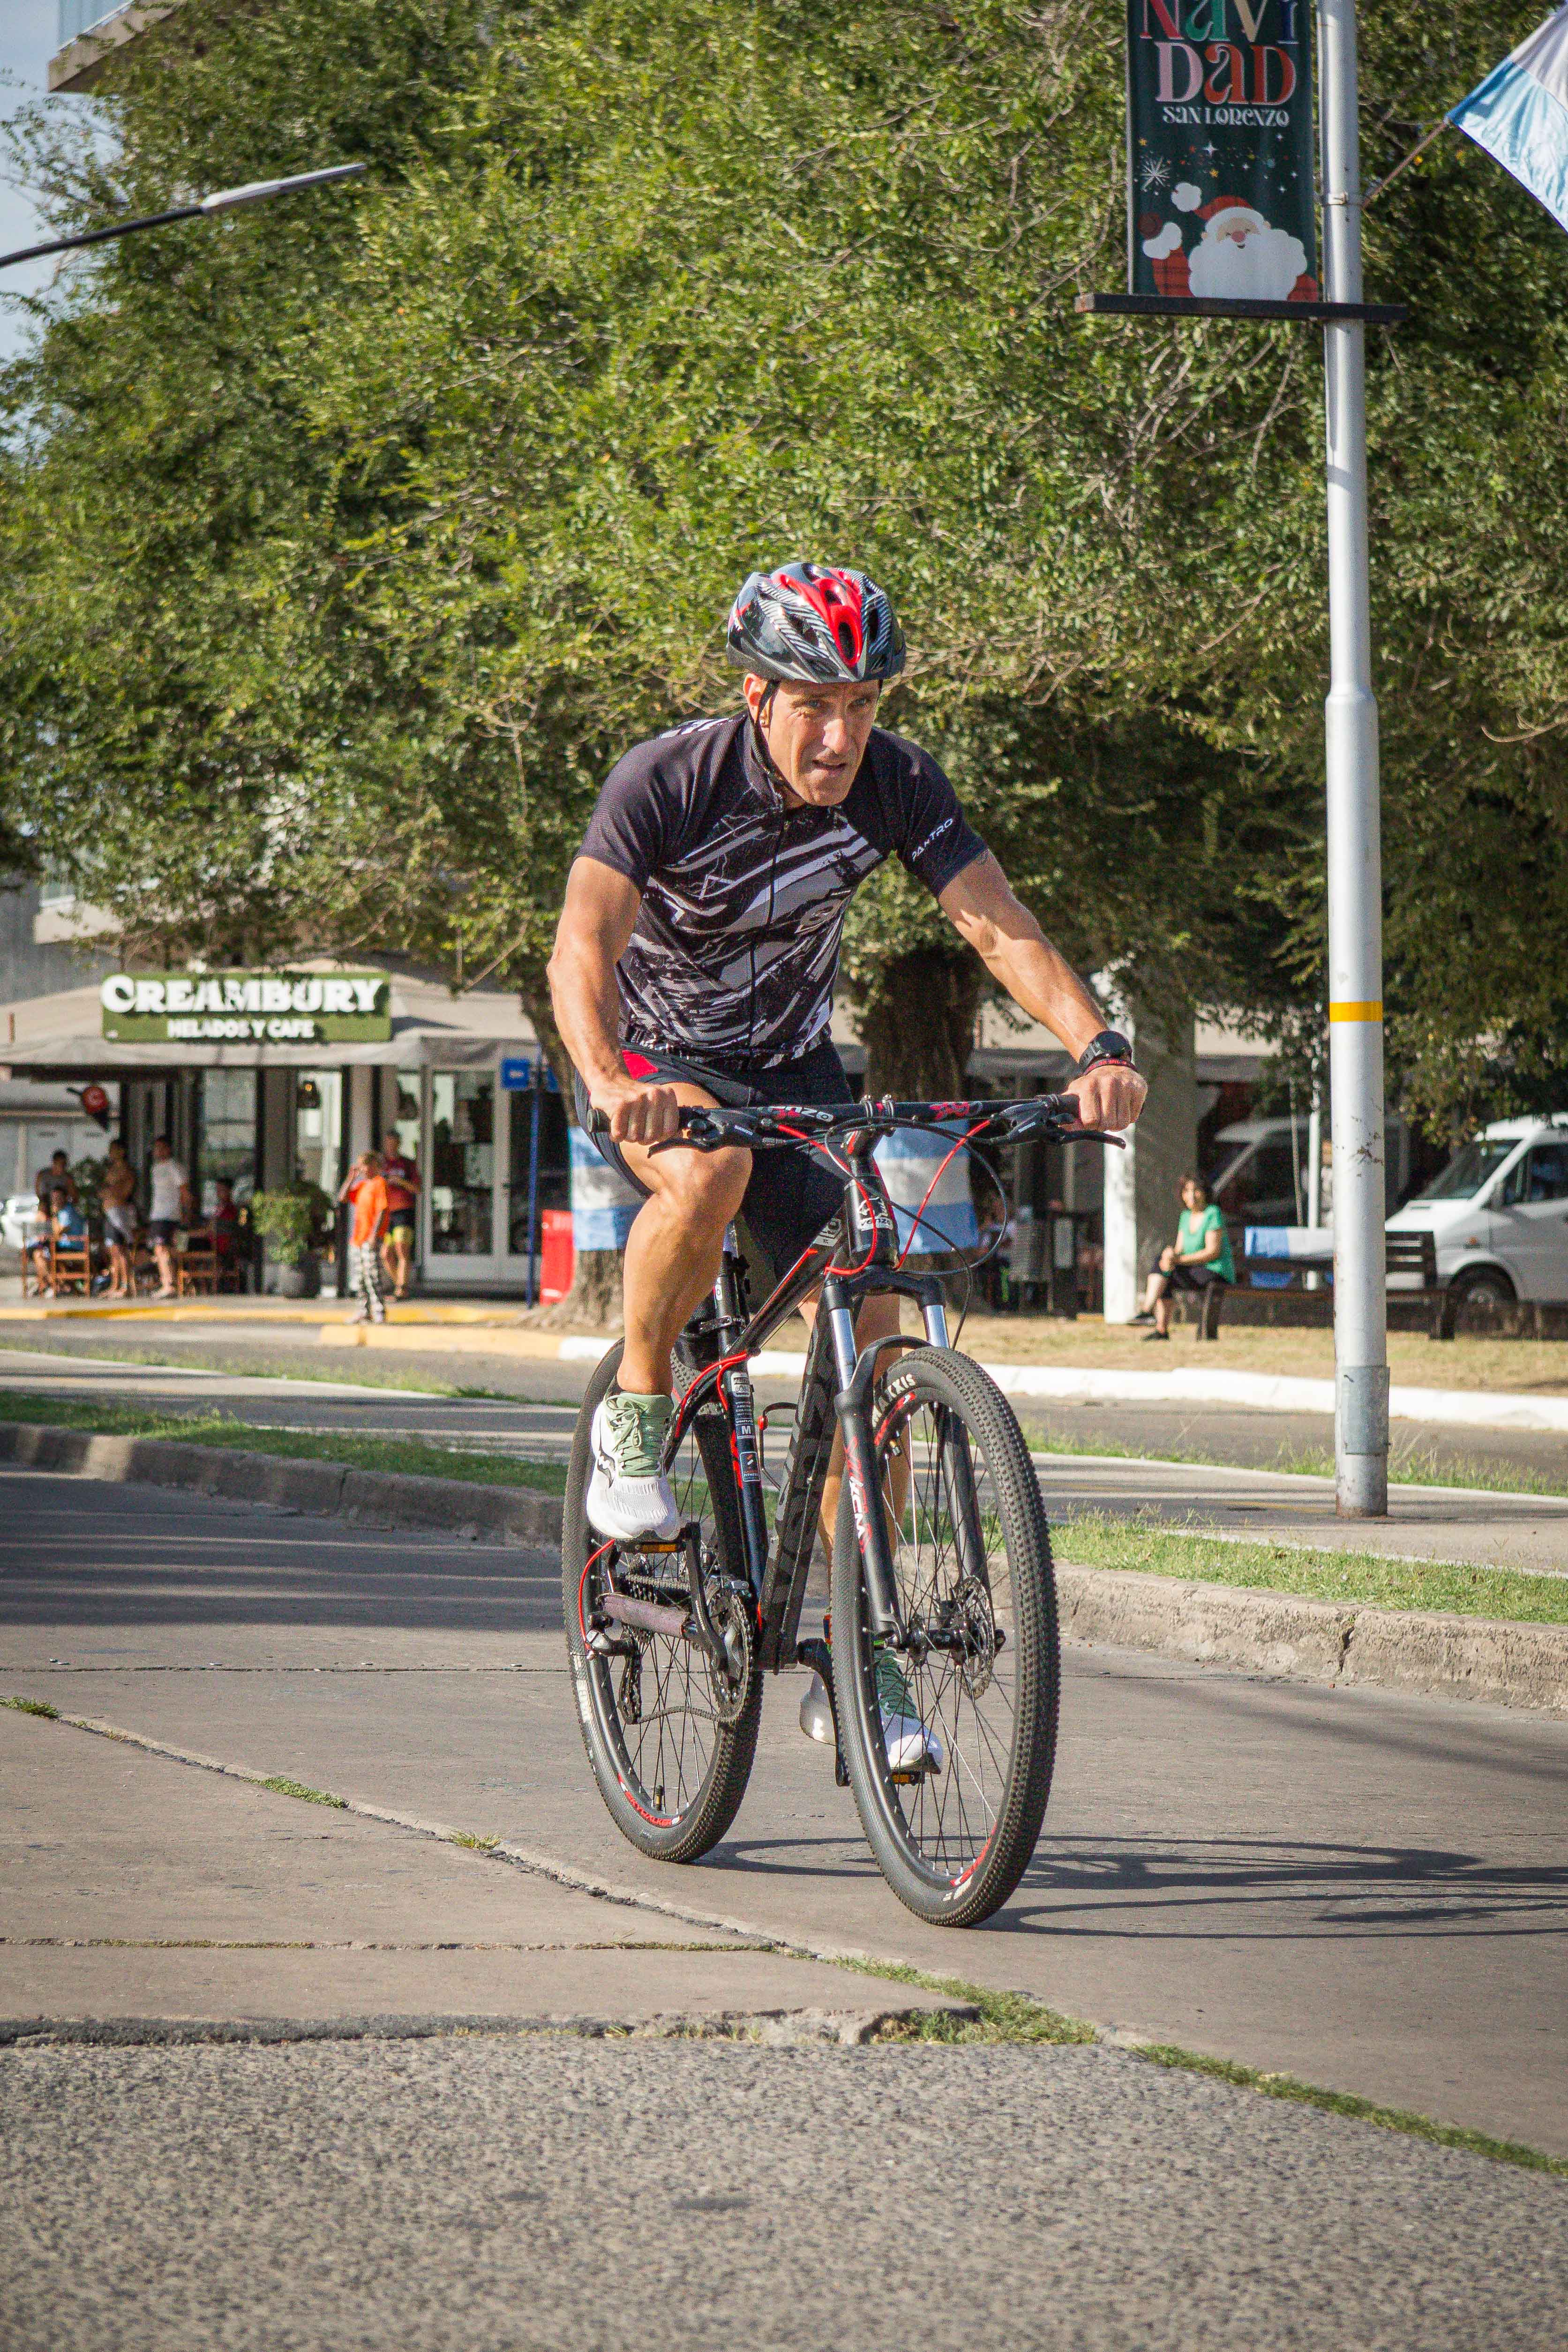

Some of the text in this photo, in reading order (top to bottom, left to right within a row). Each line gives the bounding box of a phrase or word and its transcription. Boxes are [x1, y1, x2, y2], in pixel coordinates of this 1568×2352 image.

[101, 974, 383, 1013] CREAMBURY
[168, 1019, 249, 1038] HELADOS
[252, 1019, 266, 1038] Y
[741, 1426, 751, 1435] M
